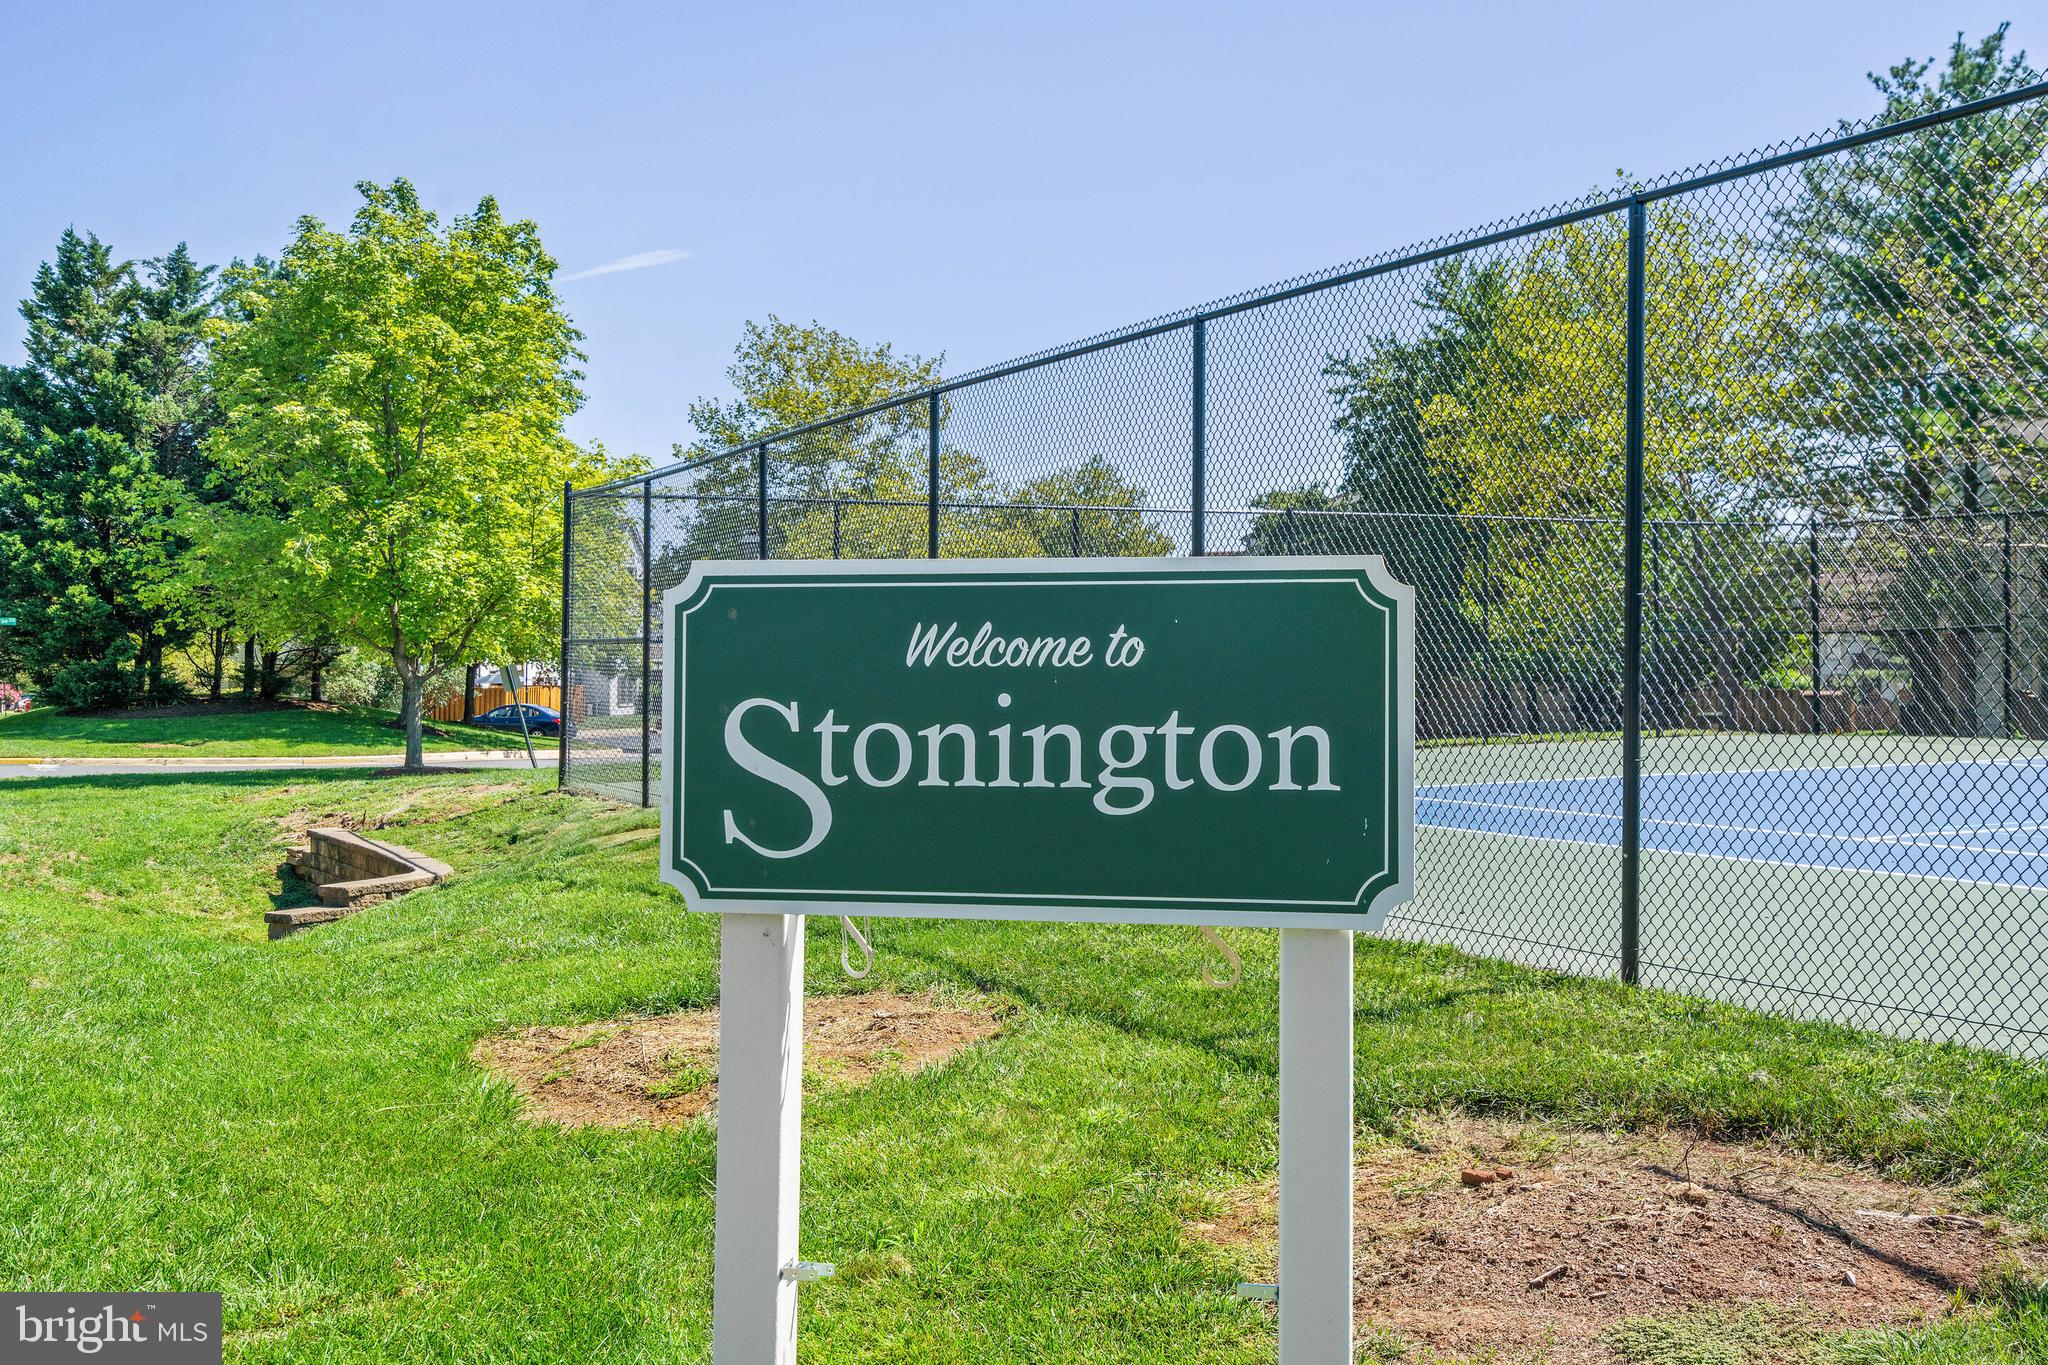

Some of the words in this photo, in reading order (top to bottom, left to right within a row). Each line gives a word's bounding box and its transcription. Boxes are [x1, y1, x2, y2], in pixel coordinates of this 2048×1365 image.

[905, 621, 1093, 668] Welcome
[1105, 623, 1146, 668] to
[723, 692, 1342, 860] Stonington
